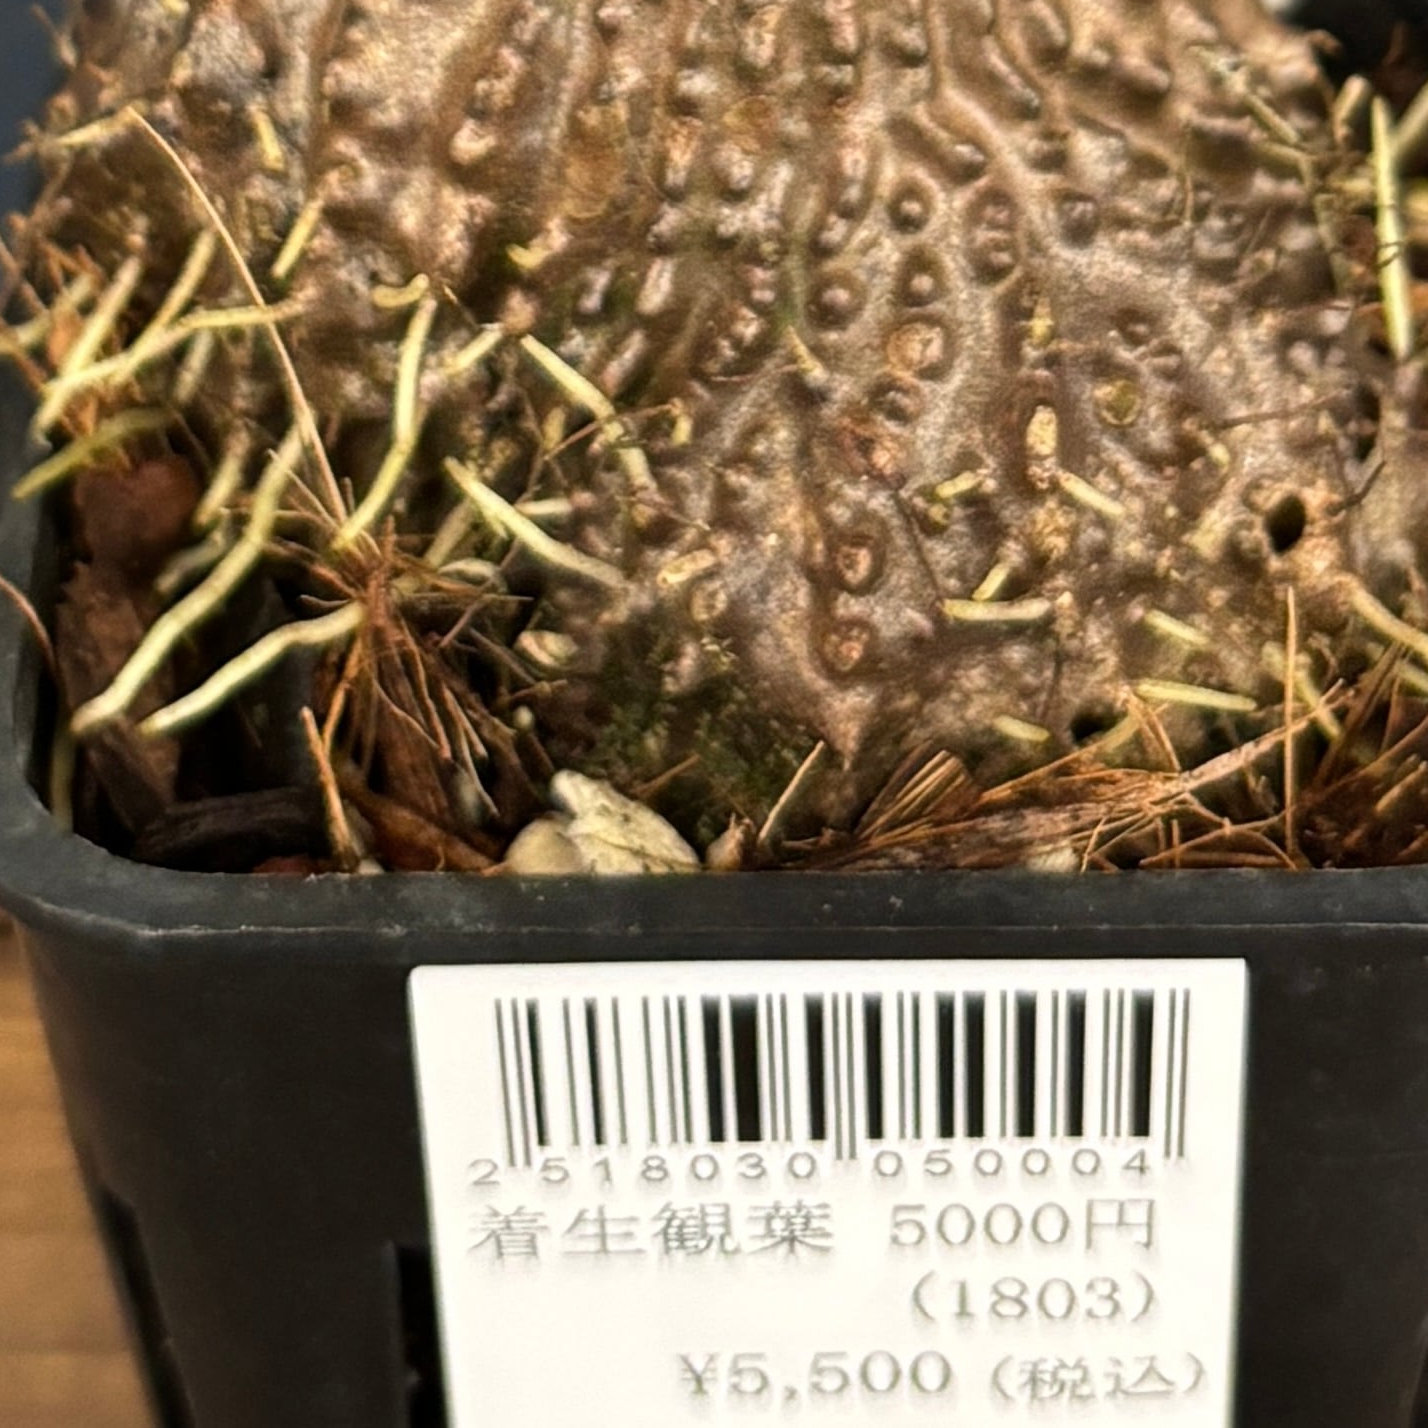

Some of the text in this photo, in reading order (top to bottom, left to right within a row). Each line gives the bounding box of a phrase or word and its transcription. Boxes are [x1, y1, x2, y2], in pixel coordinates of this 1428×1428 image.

[469, 1199, 1156, 1257] 着生観葉 5000円
[912, 1271, 1157, 1321] (1803)
[680, 1352, 954, 1401] ¥5,500
